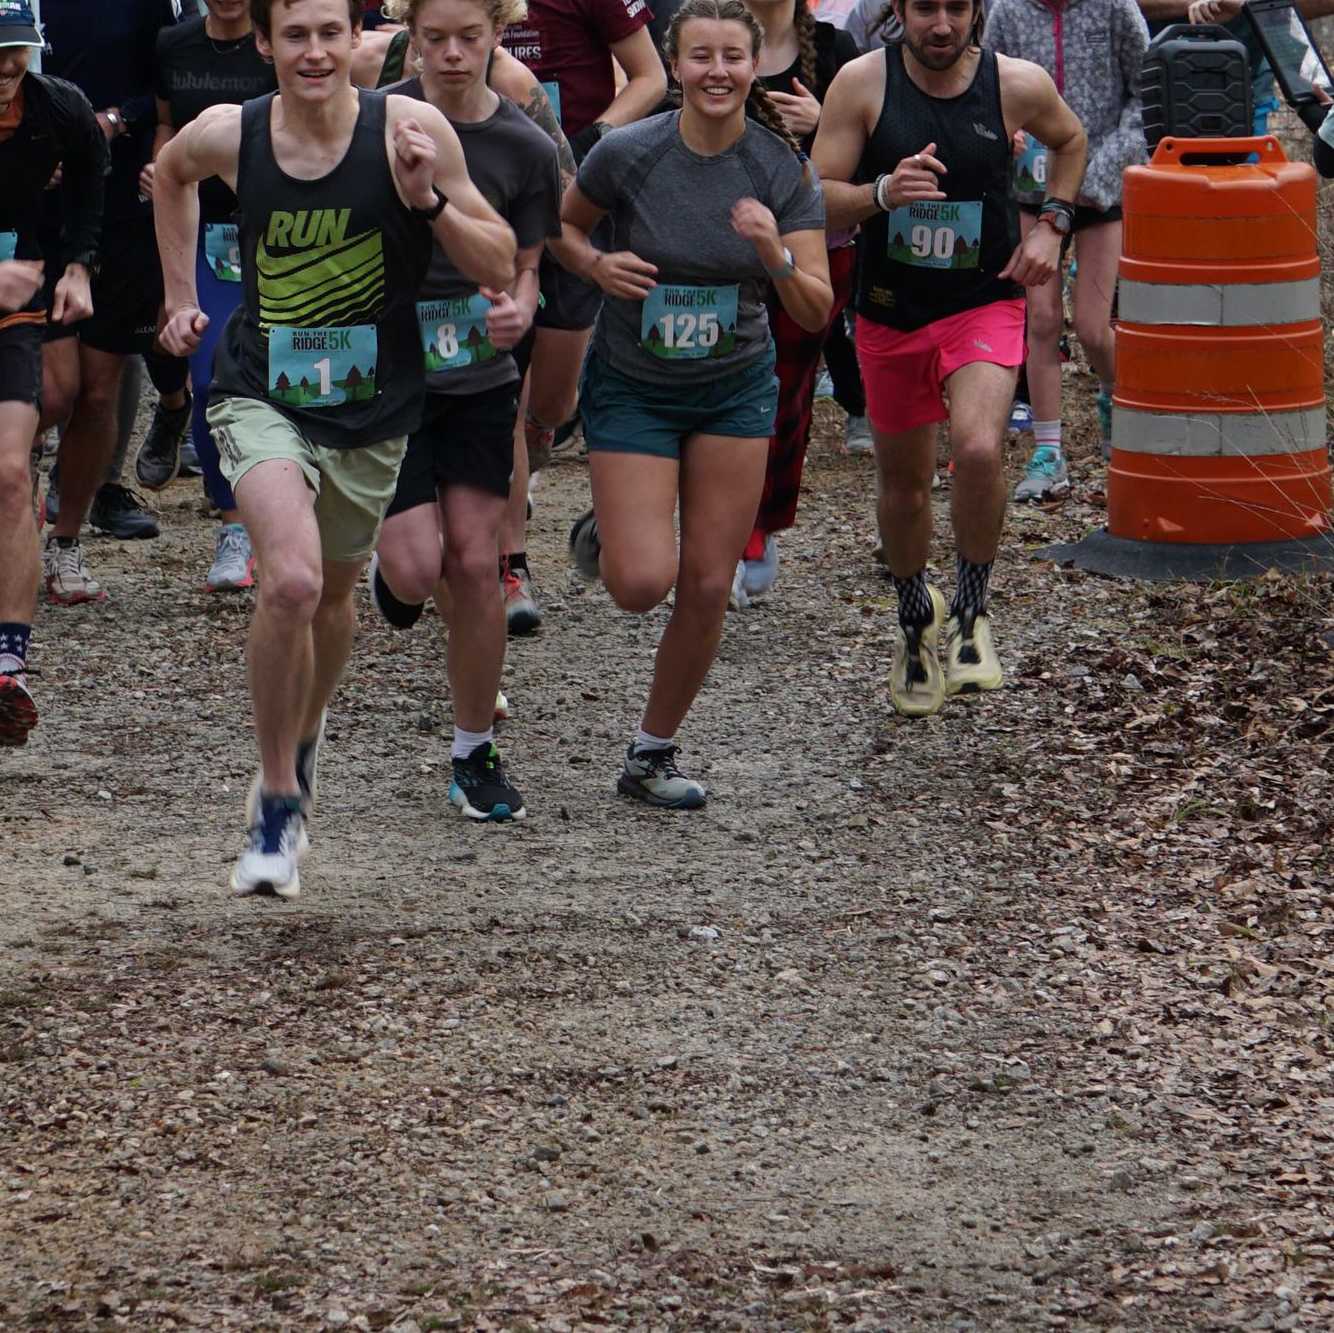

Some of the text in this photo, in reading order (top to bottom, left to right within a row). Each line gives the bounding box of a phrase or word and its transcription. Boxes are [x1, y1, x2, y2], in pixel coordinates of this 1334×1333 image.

[266, 208, 352, 247] RUN
[909, 204, 960, 221] RIDGE 5K
[911, 225, 955, 259] 90
[421, 298, 471, 322] RIDGE 5K
[664, 289, 717, 306] RIDGE 5K
[292, 330, 352, 350] RIDGE 5K
[437, 324, 459, 359] 8
[660, 313, 719, 348] 125
[313, 358, 331, 395] 1
